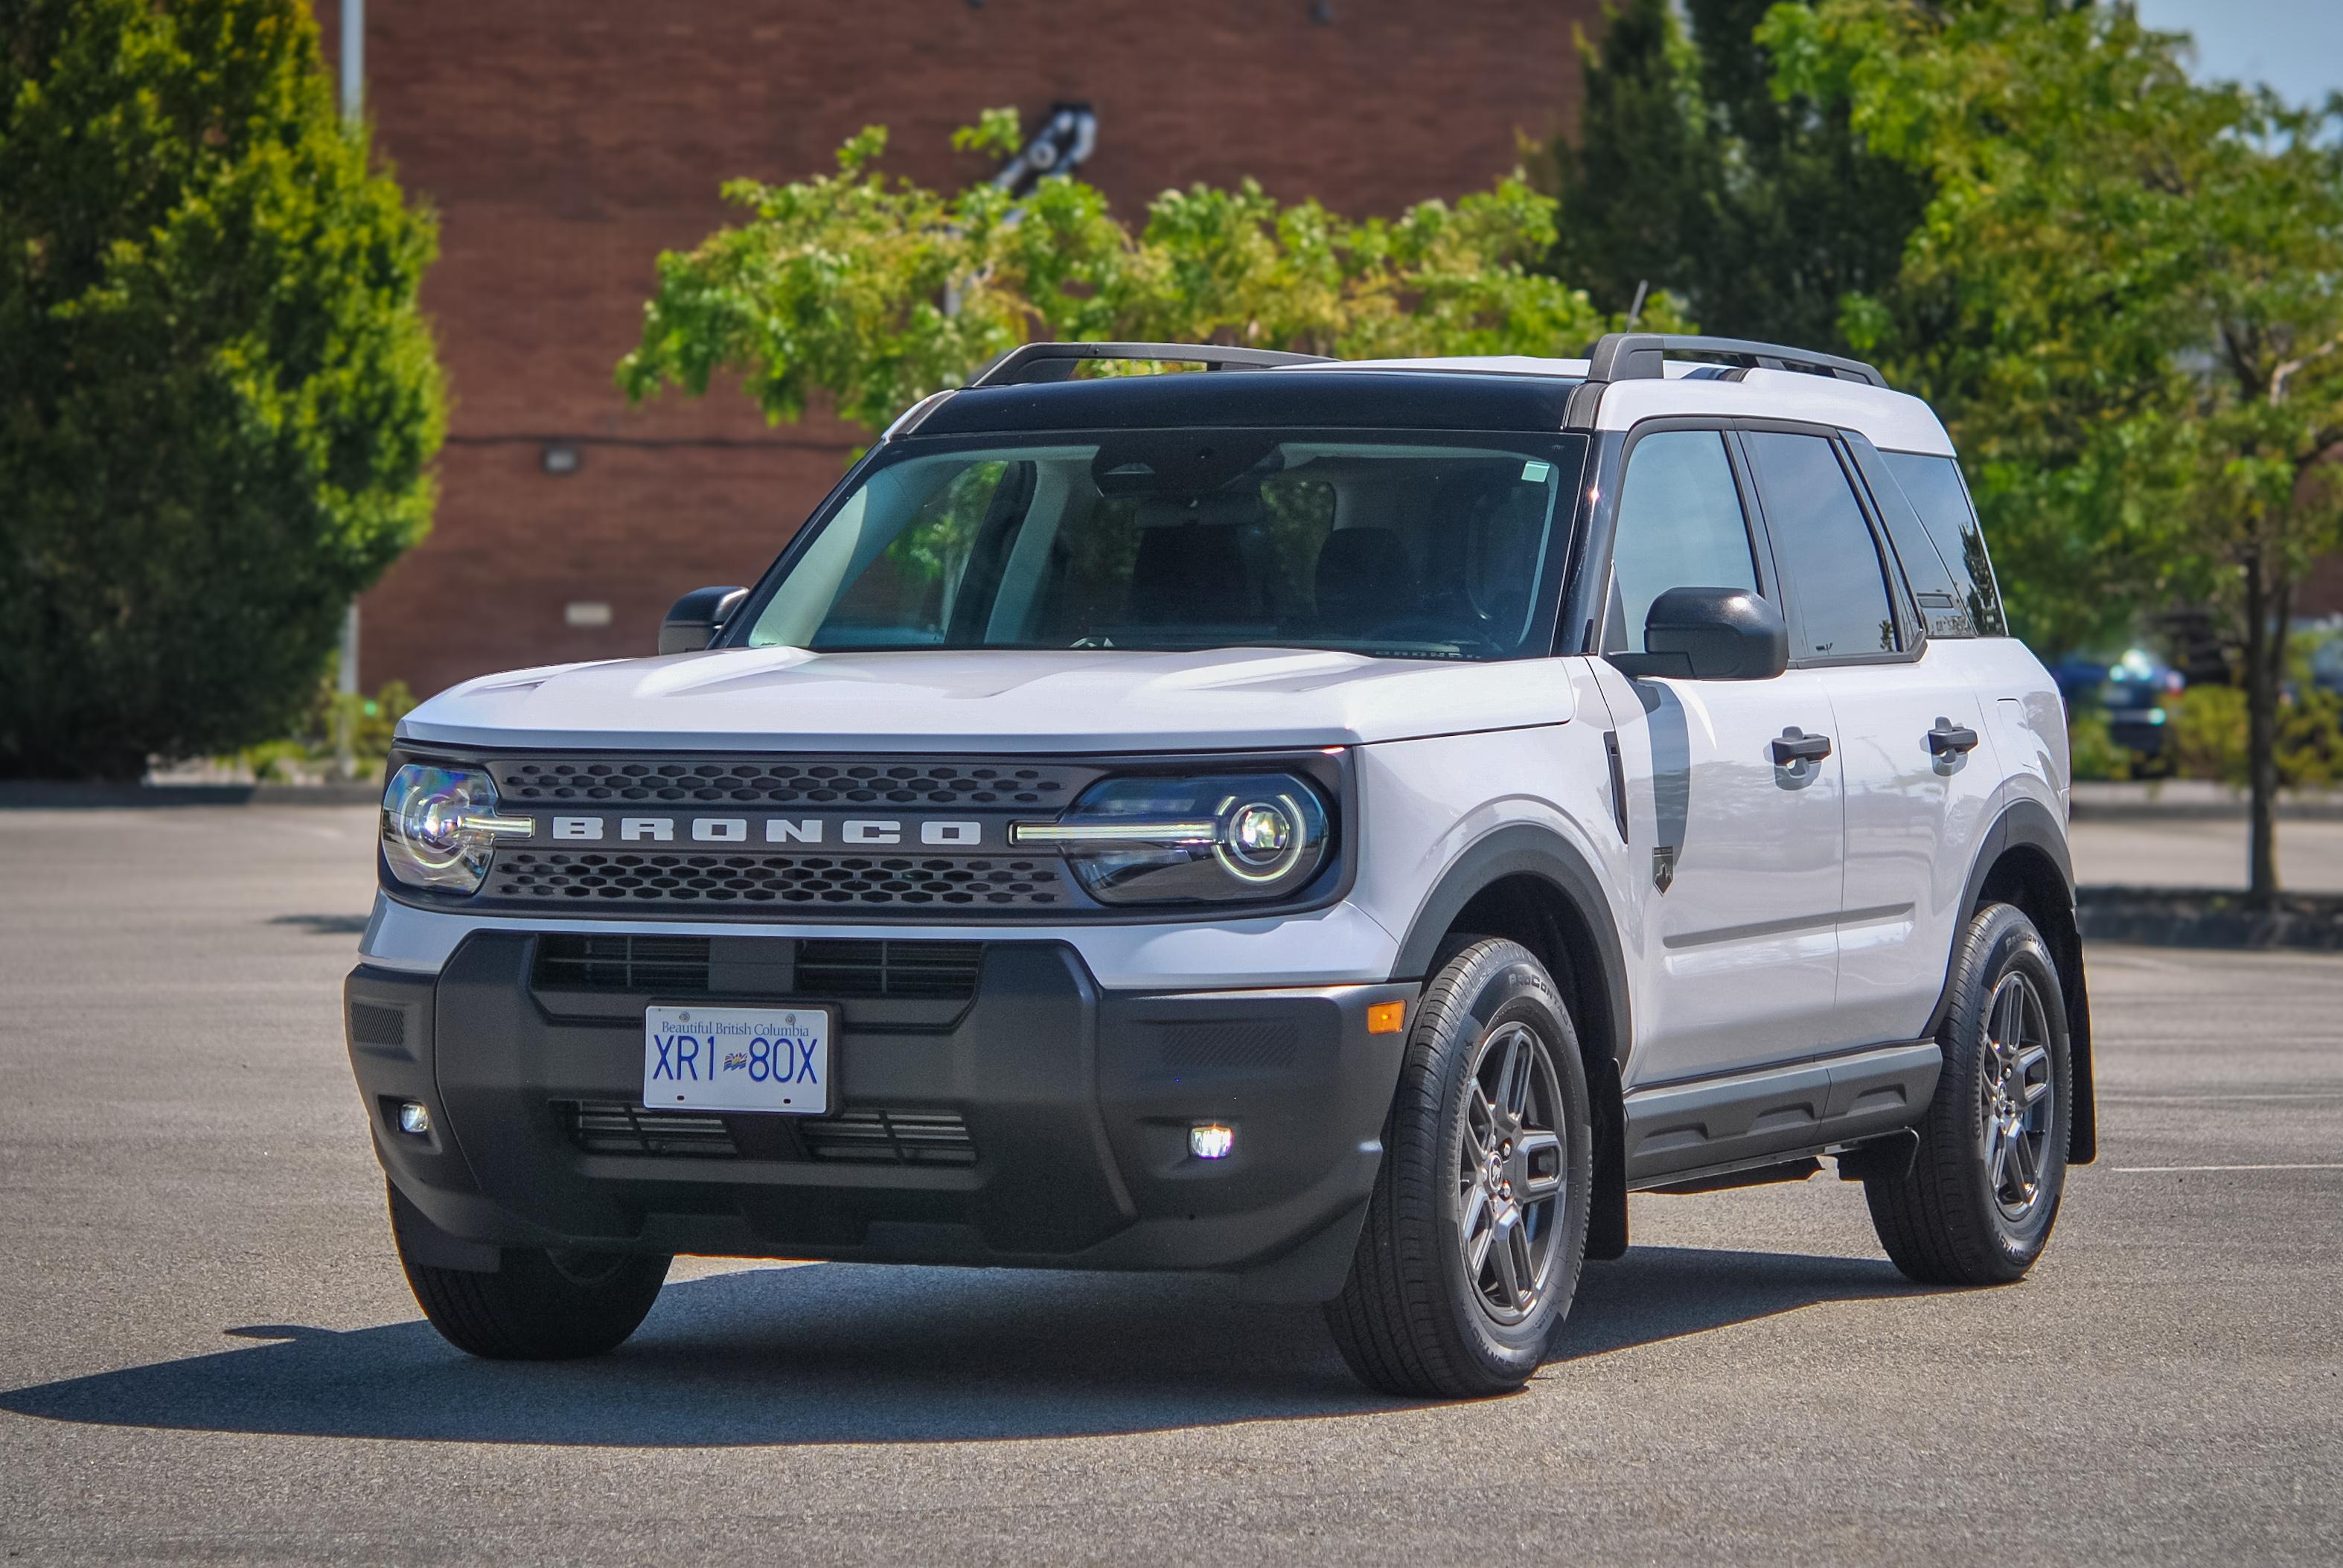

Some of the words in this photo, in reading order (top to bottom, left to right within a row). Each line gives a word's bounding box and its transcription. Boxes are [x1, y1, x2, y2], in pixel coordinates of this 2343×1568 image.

[552, 816, 981, 845] BRONCO
[662, 1021, 712, 1034] Beautiful
[716, 1023, 752, 1035] British
[755, 1024, 809, 1037] Columbia
[653, 1034, 715, 1081] XR1
